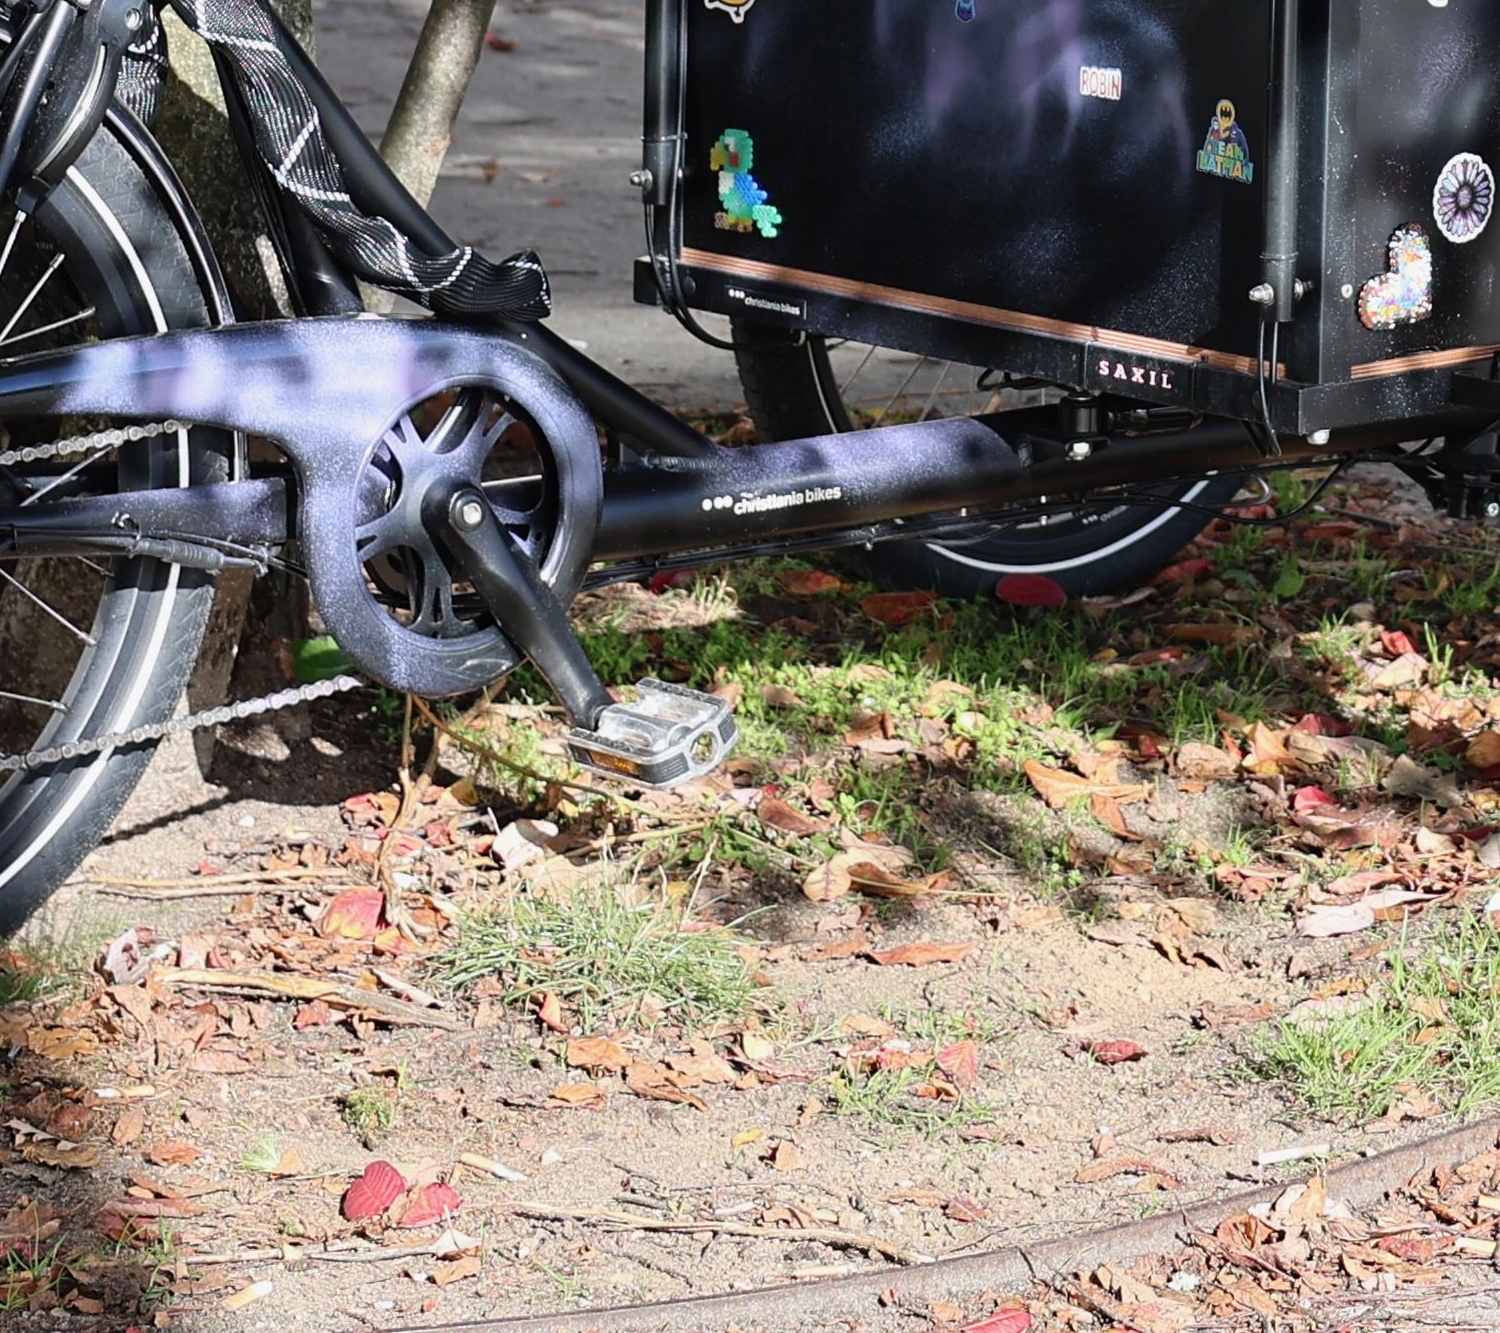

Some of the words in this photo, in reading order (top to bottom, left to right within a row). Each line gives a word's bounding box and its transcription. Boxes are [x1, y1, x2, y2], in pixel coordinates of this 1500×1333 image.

[1082, 69, 1120, 98] ROBIN
[1197, 151, 1254, 183] BATMAN
[744, 296, 780, 312] christiania
[781, 303, 800, 315] bikes
[1099, 360, 1172, 389] SAXIL
[733, 491, 804, 516] christiania
[805, 486, 842, 503] bikes
